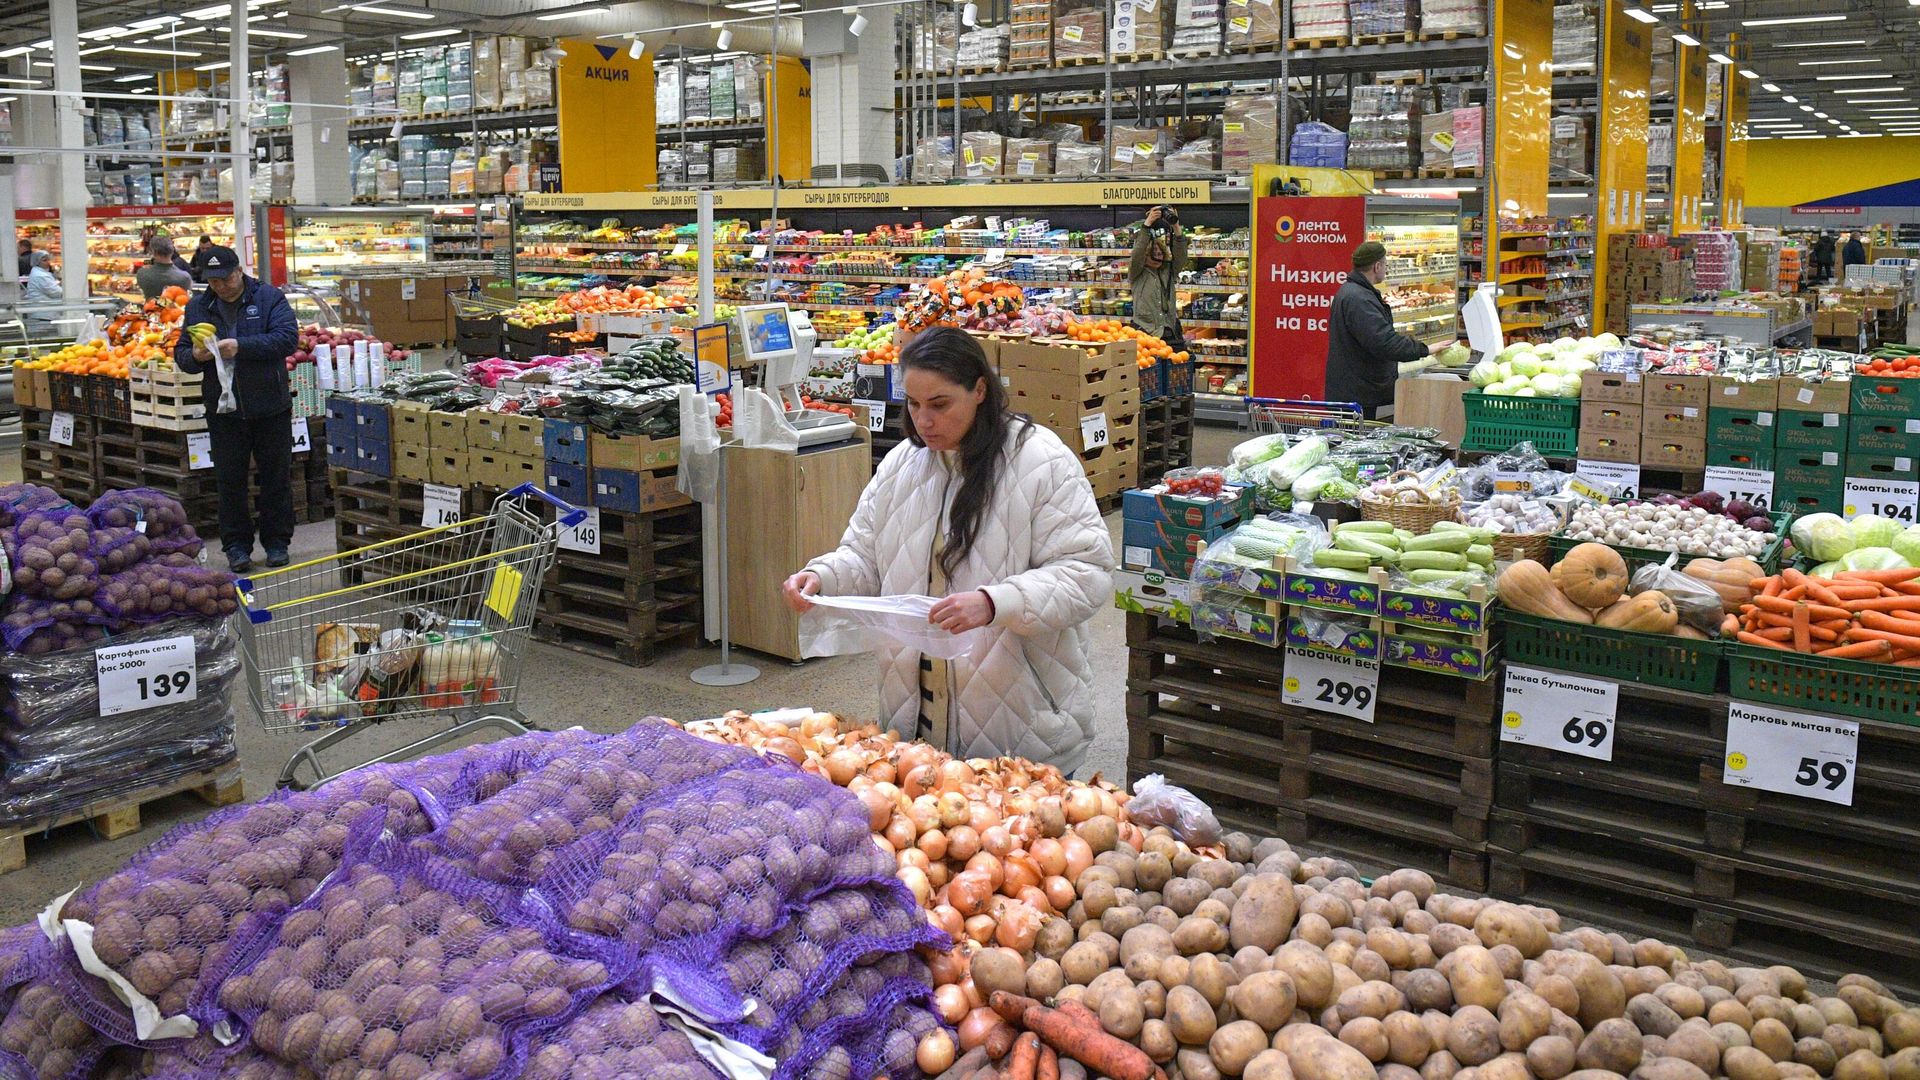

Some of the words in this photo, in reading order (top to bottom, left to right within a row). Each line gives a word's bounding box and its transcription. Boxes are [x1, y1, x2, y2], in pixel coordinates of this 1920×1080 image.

[585, 66, 629, 82] АКЦИЯ
[542, 173, 560, 184] цену
[652, 196, 669, 206] СЫРЫ
[670, 196, 682, 206] ДЛЯ
[805, 194, 825, 204] СЫРЫ
[827, 193, 841, 204] ДЛЯ
[843, 191, 890, 203] БУТЕРБРОДОВ
[1103, 187, 1166, 200] БЛАГОРОДНЫЕ
[1169, 187, 1198, 199] СЫРЫ
[540, 197, 550, 206] ДЛЯ
[551, 197, 584, 206] БУТЕРБРОДОВ
[1271, 264, 1347, 284] Низкие
[1276, 316, 1300, 330] на
[1307, 318, 1328, 331] вс
[1094, 430, 1105, 442] 89
[1717, 434, 1761, 443] КУЛЬТУРА
[1787, 436, 1833, 446] КУЛЬТУРА
[1859, 440, 1906, 450] КУЛЬТУРА
[1515, 481, 1530, 491] 39
[1846, 482, 1890, 493] Томаты
[1894, 487, 1917, 495] вес.
[1586, 489, 1602, 501] 154
[1730, 491, 1767, 507] 176
[439, 509, 459, 526] 149
[1872, 503, 1912, 521] 194
[573, 526, 595, 545] 149
[1307, 593, 1356, 607] CAPITAL
[1405, 612, 1457, 626] CAPITAL
[98, 649, 150, 661] Картофель
[152, 644, 177, 653] сетка
[99, 665, 117, 675] фас
[119, 660, 147, 670] 5000г
[1355, 659, 1378, 671] вес
[1408, 656, 1459, 671] CAPITAL
[137, 670, 191, 700] 139
[1507, 671, 1539, 683] Тыква
[1541, 677, 1606, 695] бутылочная
[1315, 678, 1372, 711] 299
[1730, 709, 1788, 726] Морковь
[1791, 721, 1831, 733] мытая
[1835, 728, 1855, 737] вес
[1562, 717, 1607, 748] 69
[1795, 757, 1847, 791] 59
